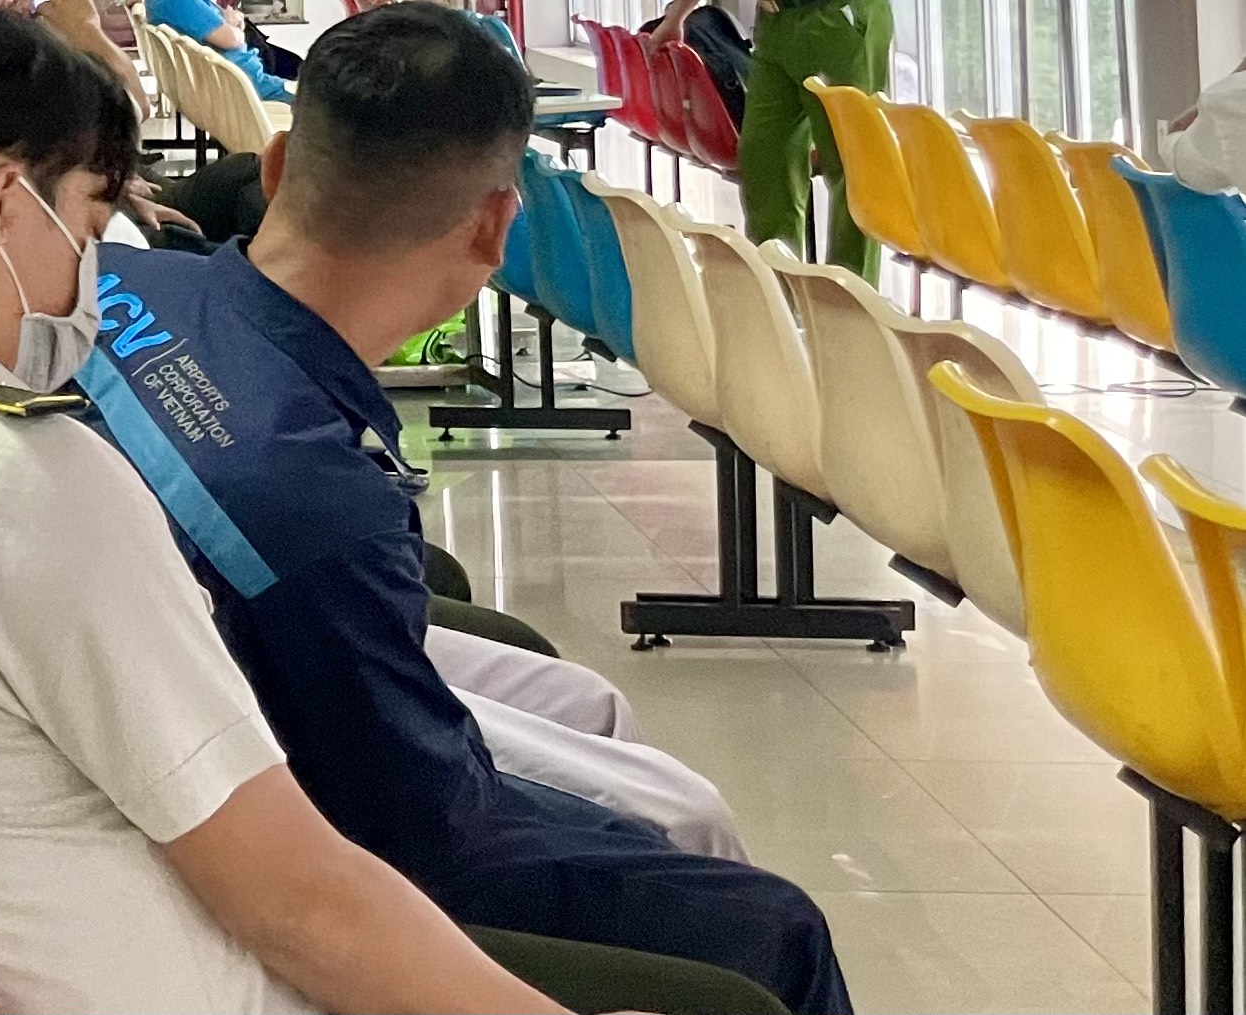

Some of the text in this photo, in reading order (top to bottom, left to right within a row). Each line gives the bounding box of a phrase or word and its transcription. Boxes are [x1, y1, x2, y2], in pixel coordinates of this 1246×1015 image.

[143, 373, 205, 443] OF VIETNAM
[158, 364, 235, 448] CORPORATION
[174, 354, 230, 412] AIRPORTS
